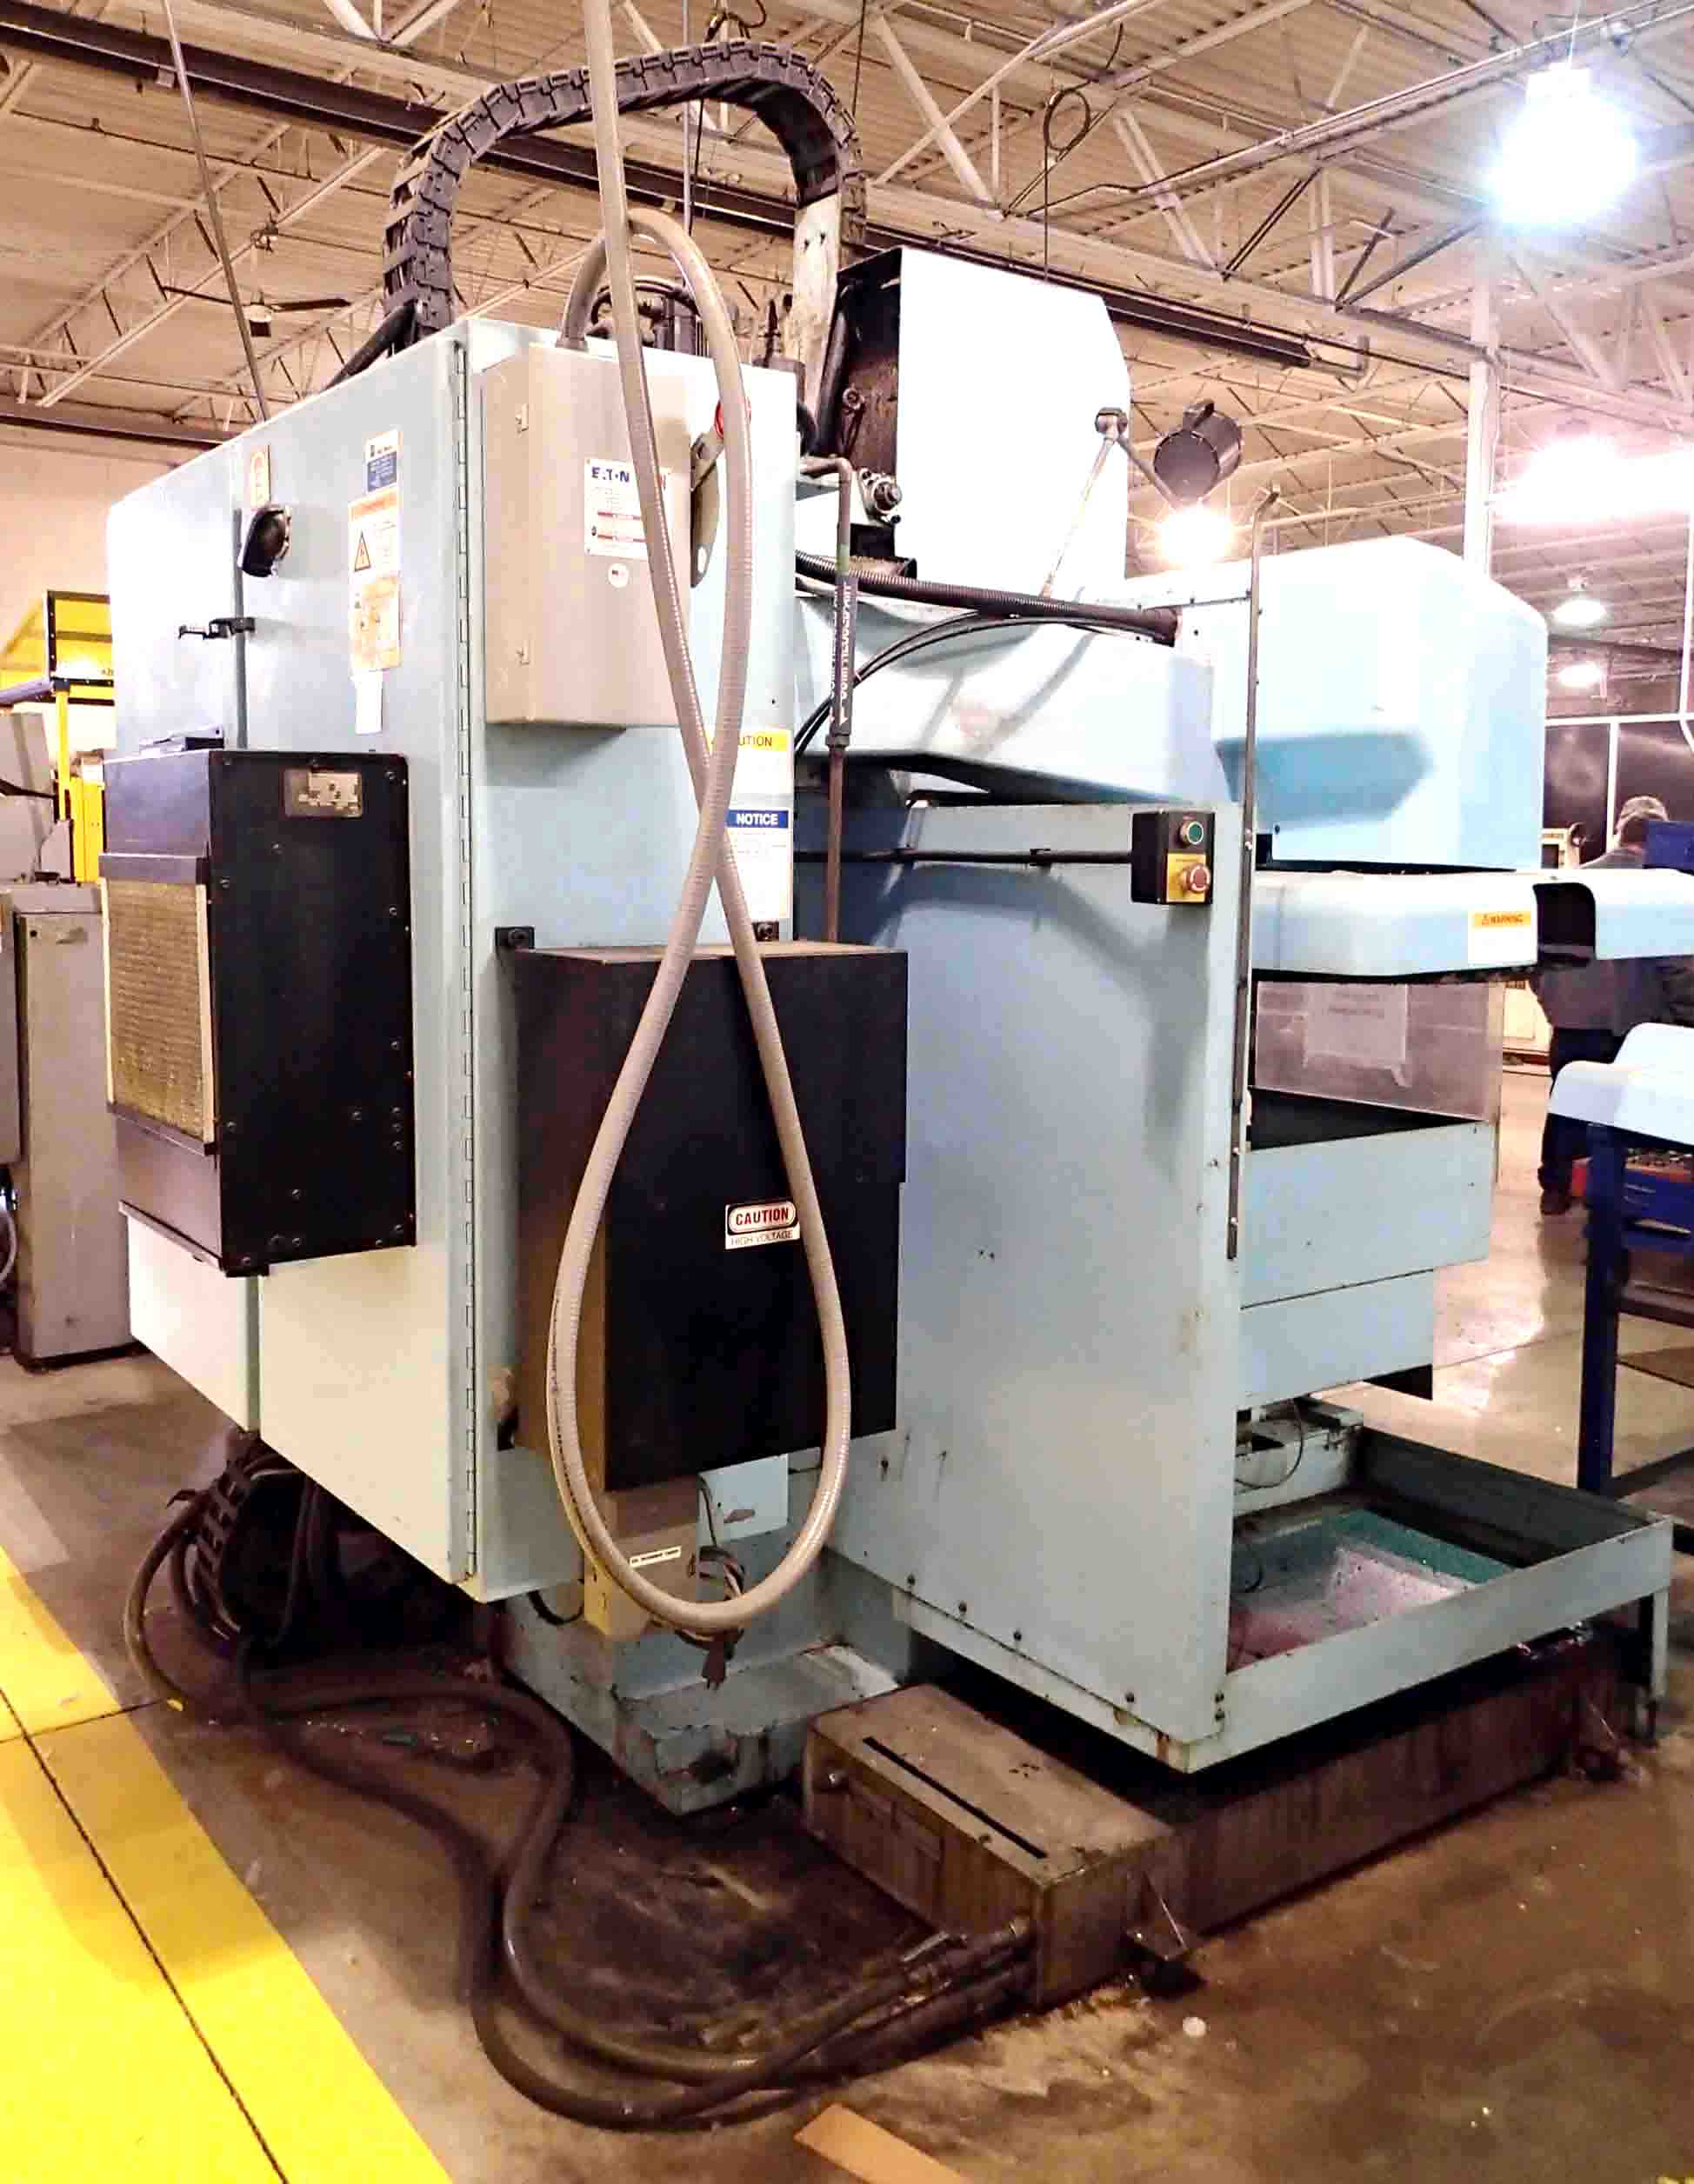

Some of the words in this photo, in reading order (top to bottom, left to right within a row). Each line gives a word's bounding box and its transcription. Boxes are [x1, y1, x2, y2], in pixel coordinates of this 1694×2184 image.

[737, 735, 773, 747] UTION
[736, 812, 779, 826] NOTICE
[735, 1208, 790, 1226] CAUTION
